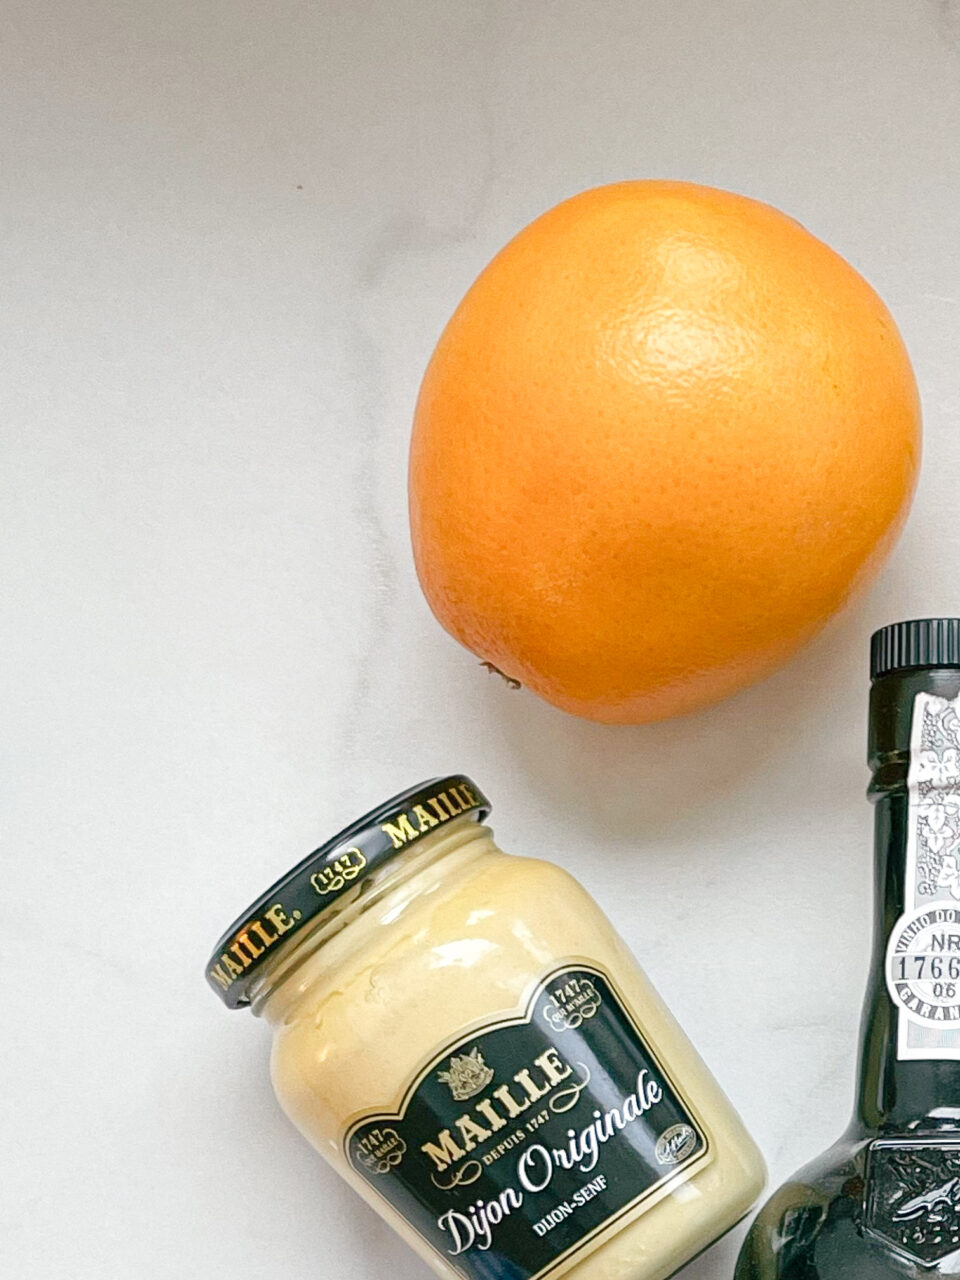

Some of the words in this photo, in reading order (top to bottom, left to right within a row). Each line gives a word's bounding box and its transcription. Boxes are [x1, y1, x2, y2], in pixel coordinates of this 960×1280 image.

[318, 854, 351, 885] 1747
[895, 915, 930, 954] VINHO
[936, 910, 956, 922] DO
[550, 979, 580, 1007] 1747
[421, 1047, 573, 1171] MAILLE
[358, 1130, 384, 1154] 1747
[438, 1187, 523, 1256] Dijon
[517, 1068, 663, 1193] Originale
[482, 1129, 526, 1165] DEPUIS
[526, 1110, 550, 1133] 1747
[532, 1174, 609, 1237] DIJON-SENF
